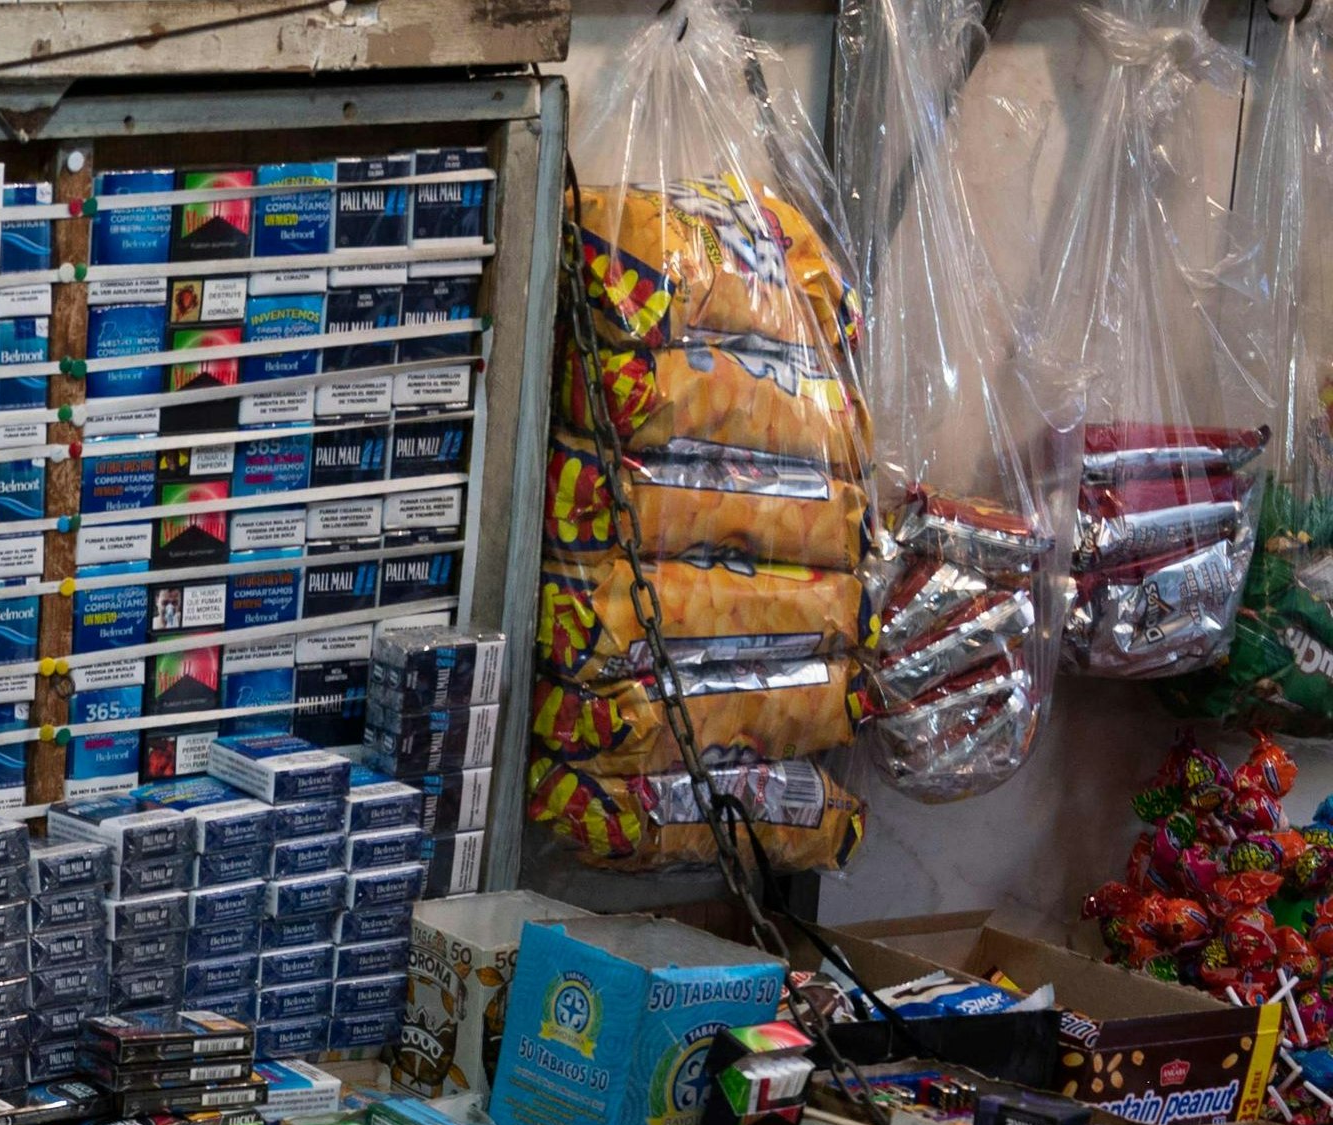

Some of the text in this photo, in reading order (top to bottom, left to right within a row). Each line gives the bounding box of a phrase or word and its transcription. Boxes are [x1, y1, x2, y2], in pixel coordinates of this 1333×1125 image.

[340, 190, 385, 211] PALL MALL
[418, 182, 461, 203] PALL MALL
[280, 229, 315, 241] Belmont
[0, 349, 44, 363] Belmont
[264, 360, 299, 371] Belmont
[315, 445, 360, 466] PALL MALL
[244, 612, 278, 624] Belmont
[100, 626, 133, 638] Belmont
[86, 702, 120, 721] 365
[451, 941, 472, 965] 50
[649, 976, 777, 1011] 50 TABACOS 50
[519, 1034, 610, 1092] 50 TABACOS 50
